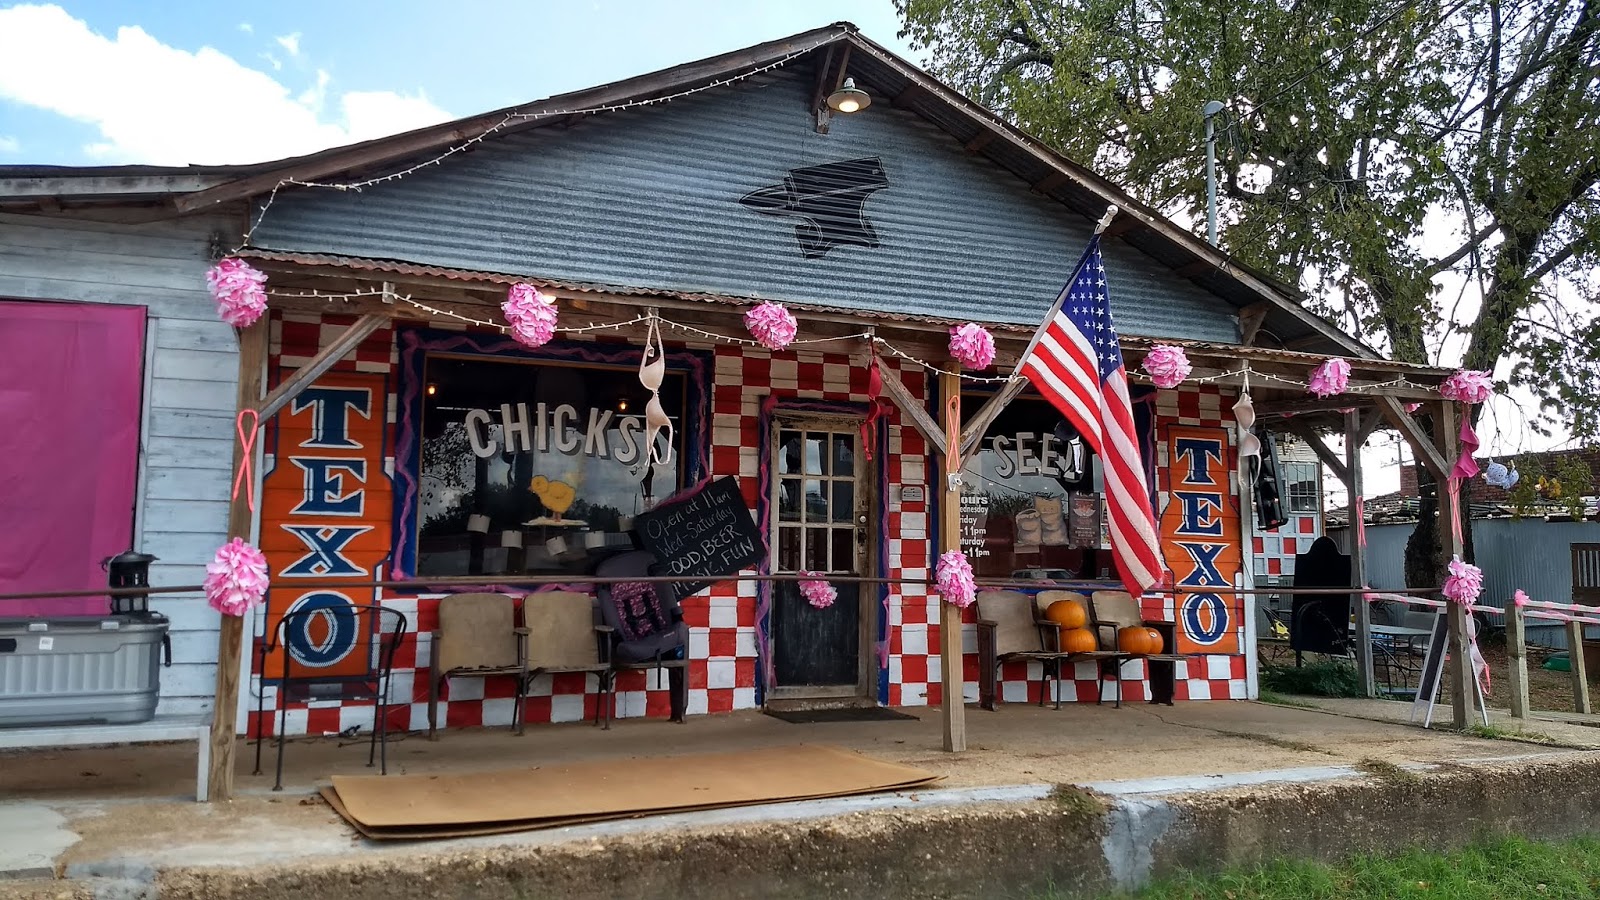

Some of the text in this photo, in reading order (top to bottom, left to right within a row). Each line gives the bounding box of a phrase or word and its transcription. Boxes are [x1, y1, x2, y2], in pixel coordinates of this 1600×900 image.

[465, 402, 644, 464] CHICKS
[647, 490, 732, 539] Open at 11am
[960, 496, 988, 505] ours
[960, 504, 989, 515] ednesday
[279, 386, 375, 667] TEXO
[960, 515, 977, 526] riday
[666, 525, 742, 575] OOD, BEER
[721, 537, 755, 566] FUN
[960, 536, 985, 547] aturday
[1171, 437, 1233, 645] TEXO
